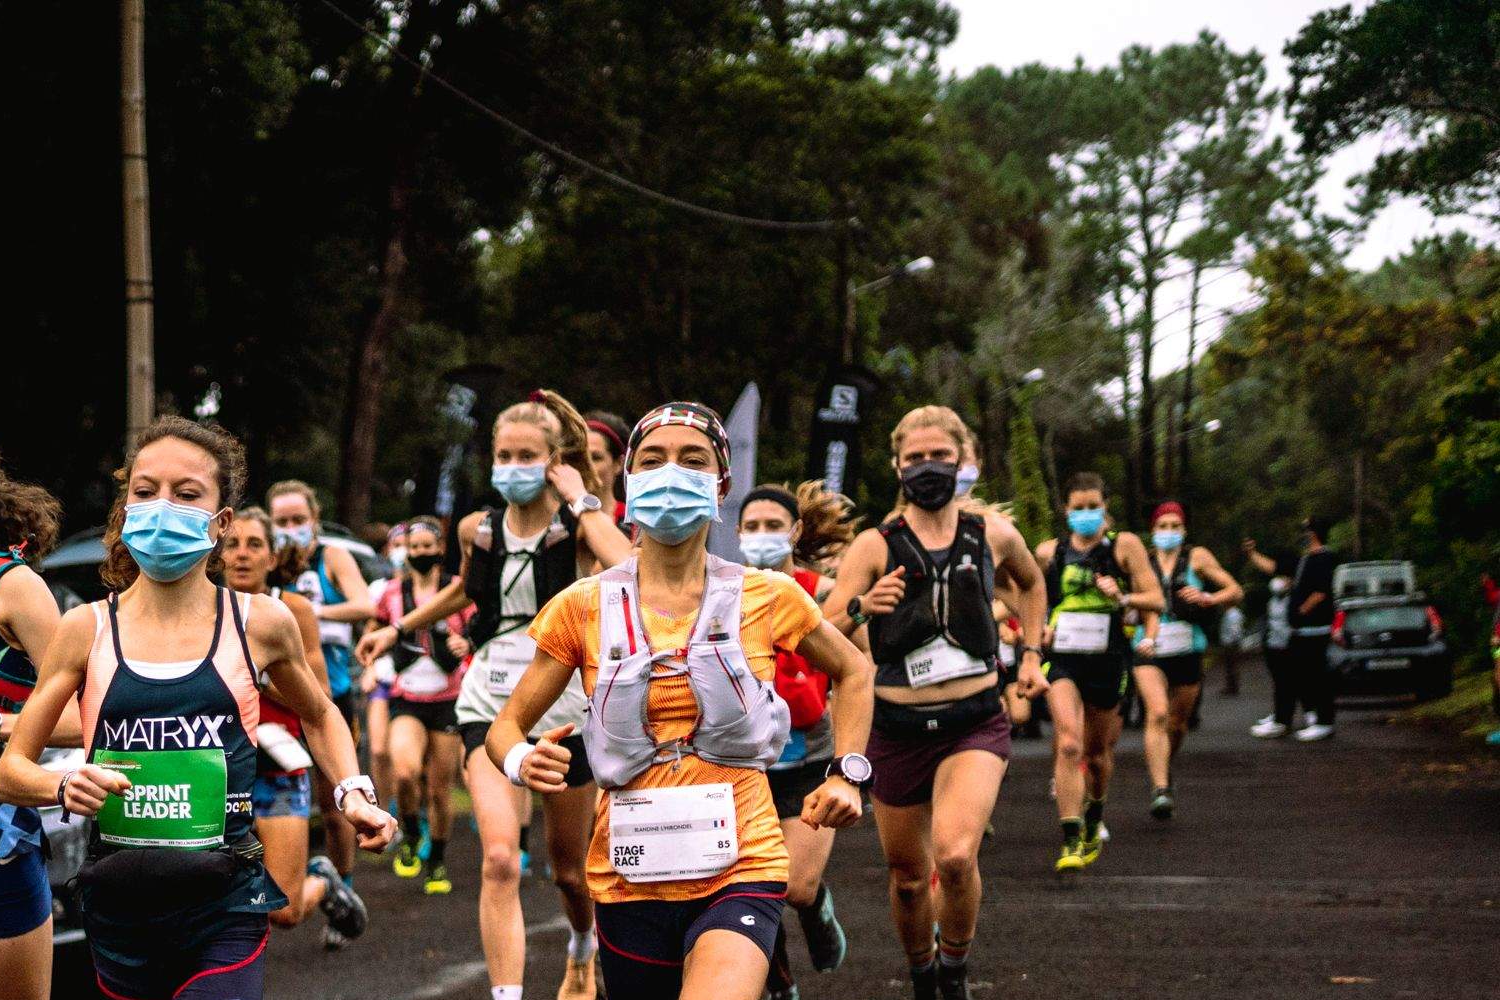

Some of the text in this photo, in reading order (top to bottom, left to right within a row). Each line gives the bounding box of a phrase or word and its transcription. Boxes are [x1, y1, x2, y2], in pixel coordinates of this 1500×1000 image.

[124, 784, 191, 801] SPRINT
[124, 802, 192, 819] LEADER
[717, 840, 730, 849] 85
[614, 845, 645, 856] STAGE
[614, 856, 640, 867] RACE
